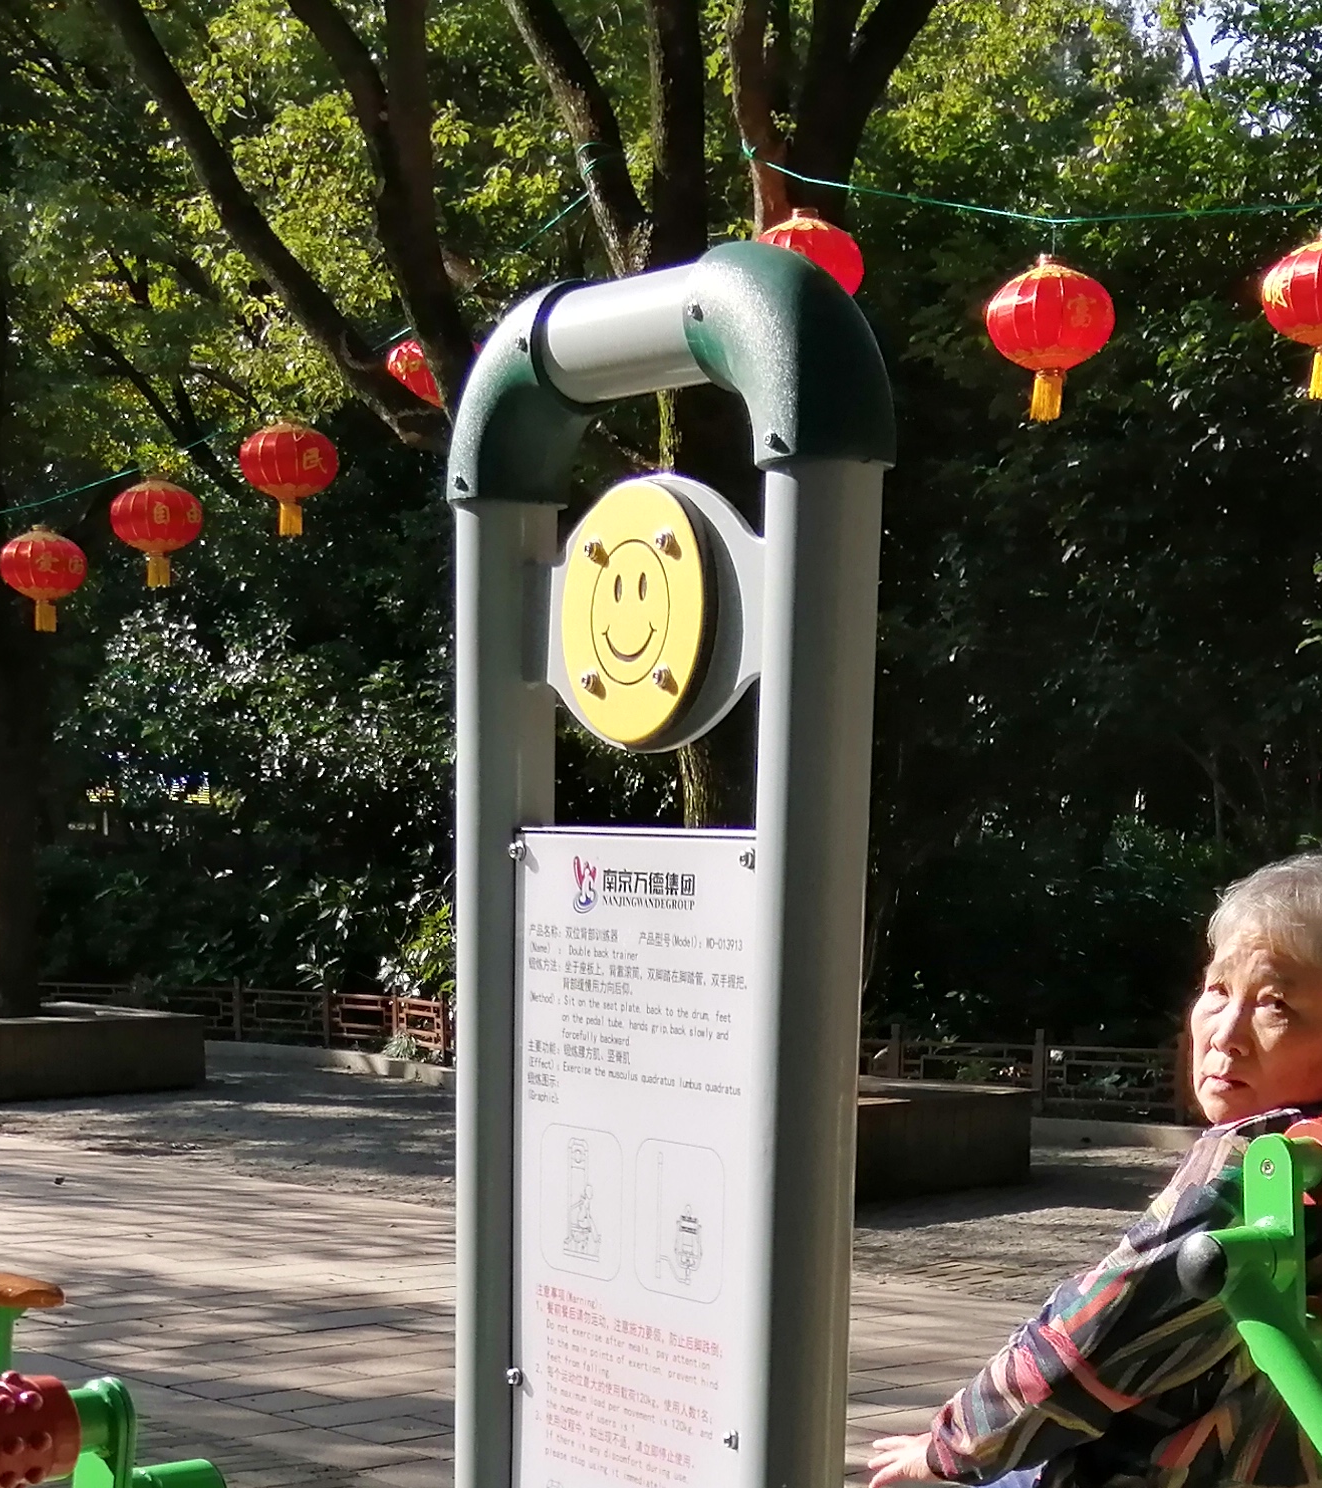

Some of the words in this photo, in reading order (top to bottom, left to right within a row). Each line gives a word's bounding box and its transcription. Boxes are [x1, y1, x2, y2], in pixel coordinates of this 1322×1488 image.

[302, 447, 328, 474] 民
[152, 501, 202, 525] 自由
[35, 551, 85, 575] 爱国
[603, 869, 695, 895] 南京万德集团
[602, 894, 694, 910] NANJINGWANDEGROUP
[568, 943, 590, 957] Double
[593, 947, 608, 958] back
[611, 949, 638, 961] trainer
[563, 994, 575, 1006] Sit
[577, 998, 586, 1007] on
[588, 997, 600, 1008] the
[602, 1001, 618, 1011] seat
[645, 1003, 662, 1015] back
[664, 1006, 674, 1017] to
[676, 1006, 689, 1019] the
[715, 1009, 731, 1023] feet
[561, 1013, 570, 1022] on
[571, 1013, 583, 1024] the
[585, 1015, 604, 1026] pedal
[628, 1018, 648, 1032] hands
[688, 1026, 713, 1040] slowly
[715, 1029, 729, 1041] and
[561, 1027, 597, 1044] forcefully
[599, 1032, 630, 1046] backward
[562, 1060, 591, 1075] Exercise
[593, 1066, 605, 1077] the
[607, 1069, 638, 1082] musculus
[640, 1073, 675, 1087] quadratus
[704, 1082, 741, 1096] quadratus
[545, 1317, 554, 1330] Do
[556, 1323, 569, 1334] not
[571, 1327, 602, 1343] exercise
[604, 1334, 625, 1348] after
[655, 1349, 669, 1362] pay
[672, 1353, 710, 1370] attention
[546, 1350, 561, 1363] feet
[564, 1354, 580, 1368] from
[546, 1335, 554, 1346] to
[556, 1338, 568, 1350] the
[571, 1343, 587, 1353] main
[589, 1348, 613, 1362] points
[615, 1353, 625, 1364] of
[667, 1369, 697, 1385] prevent
[700, 1376, 719, 1391] hind
[545, 1380, 557, 1394] The
[559, 1388, 587, 1402] maximum
[590, 1396, 605, 1409] load
[607, 1402, 620, 1412] per
[623, 1407, 655, 1424] movement
[659, 1418, 668, 1427] is
[699, 1429, 713, 1440] and
[545, 1398, 557, 1410] the
[560, 1404, 582, 1416] number
[585, 1410, 594, 1420] of
[596, 1416, 616, 1428] users
[620, 1423, 628, 1432] is
[544, 1446, 567, 1461] please
[569, 1455, 585, 1467] stop
[588, 1462, 608, 1476] using
[611, 1468, 619, 1478] it
[545, 1428, 553, 1439] If
[555, 1433, 575, 1447] there
[578, 1442, 586, 1451] is
[588, 1444, 600, 1457] any
[603, 1447, 642, 1469] discomfort
[645, 1462, 670, 1480] during
